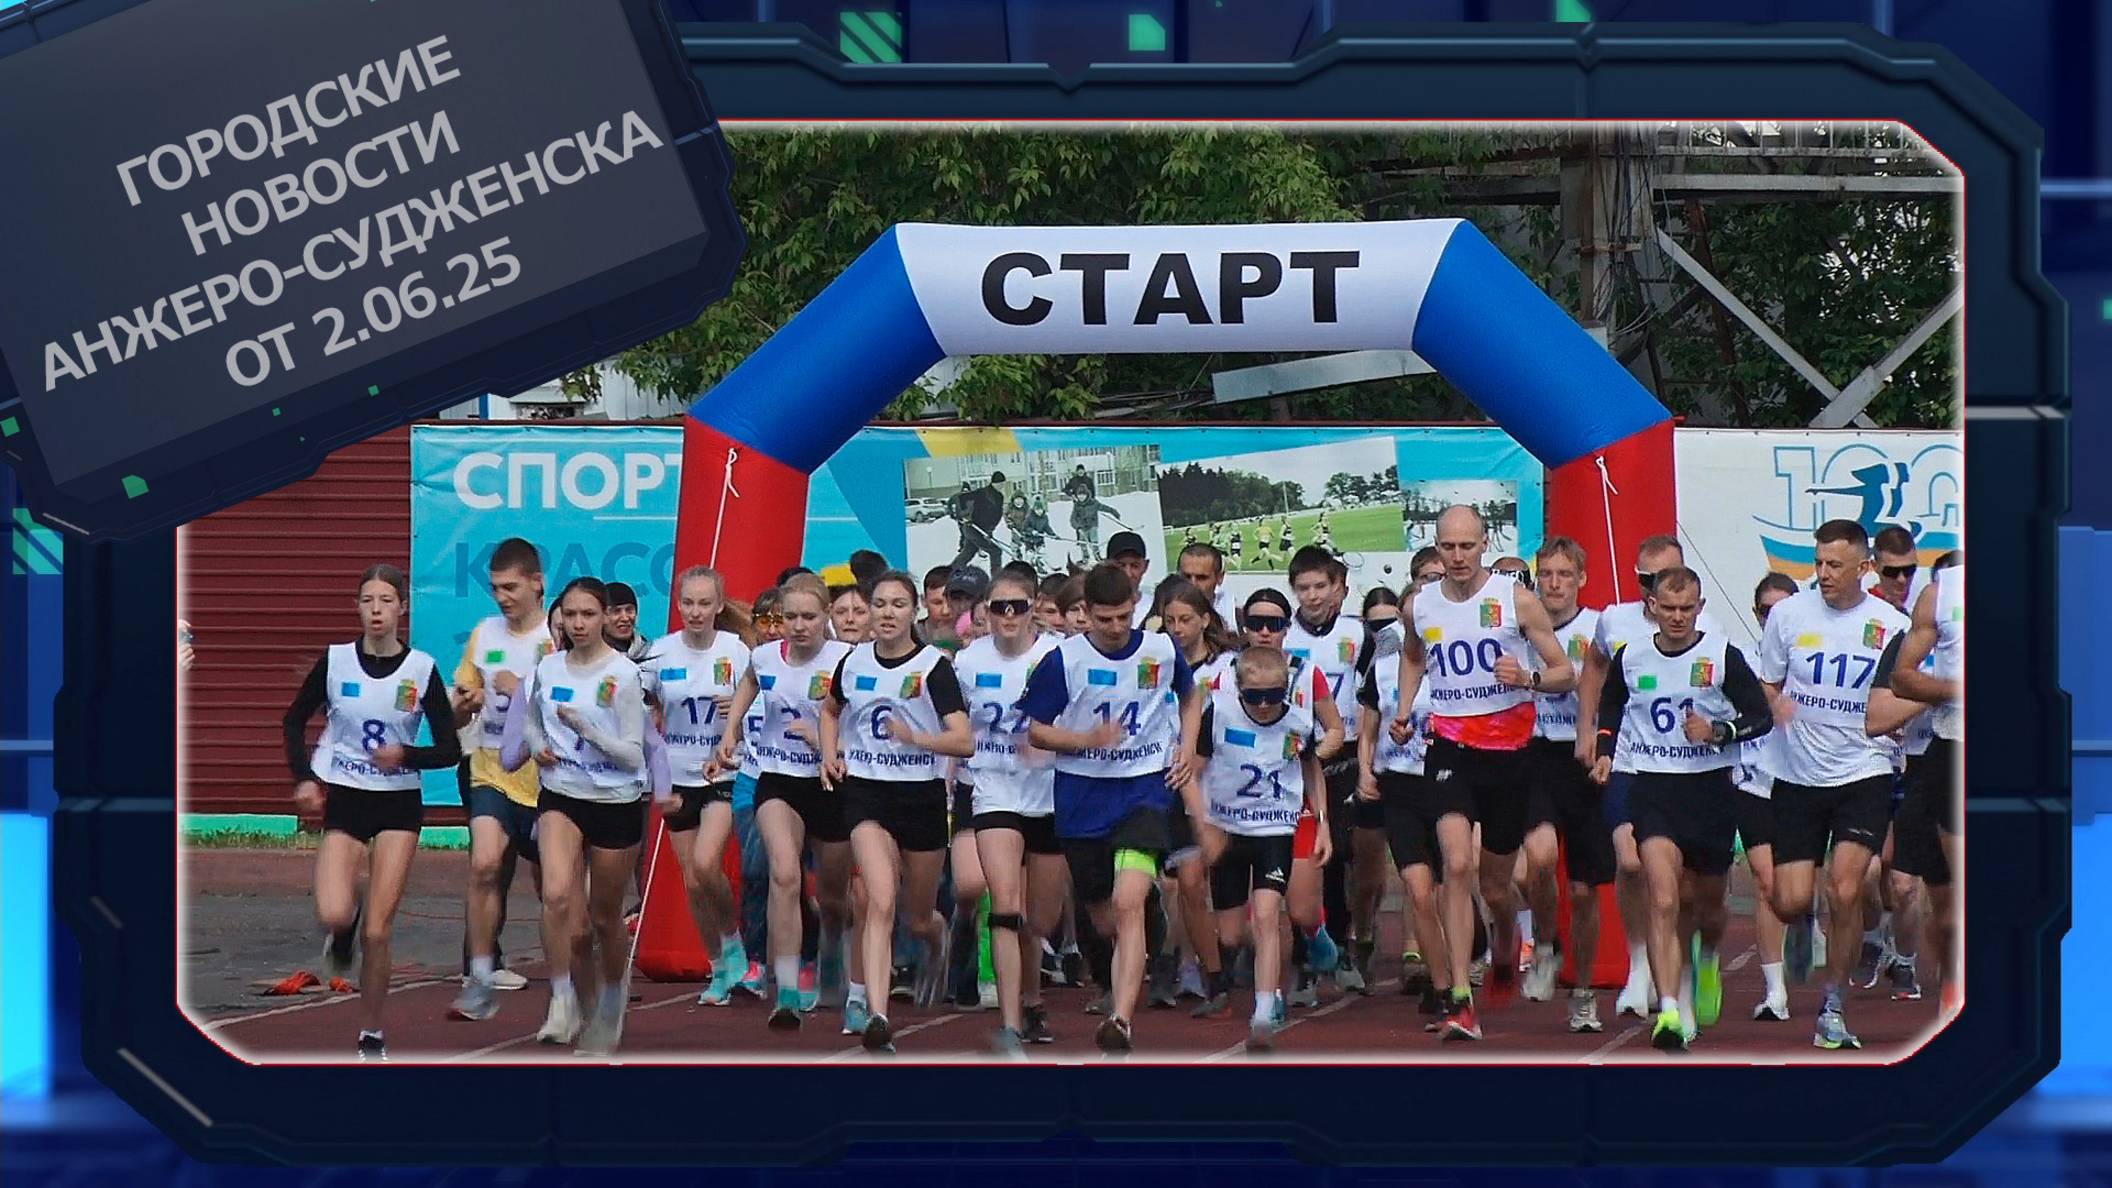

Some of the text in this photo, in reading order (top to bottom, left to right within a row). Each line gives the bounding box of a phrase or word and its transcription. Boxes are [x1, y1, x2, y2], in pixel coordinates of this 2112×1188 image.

[981, 250, 1360, 326] СТАРТ
[1430, 638, 1503, 676] 100
[1806, 651, 1876, 689] 117
[681, 697, 718, 724] 17
[1093, 701, 1141, 736] 14
[362, 719, 386, 755] 8
[1237, 764, 1284, 799] 21
